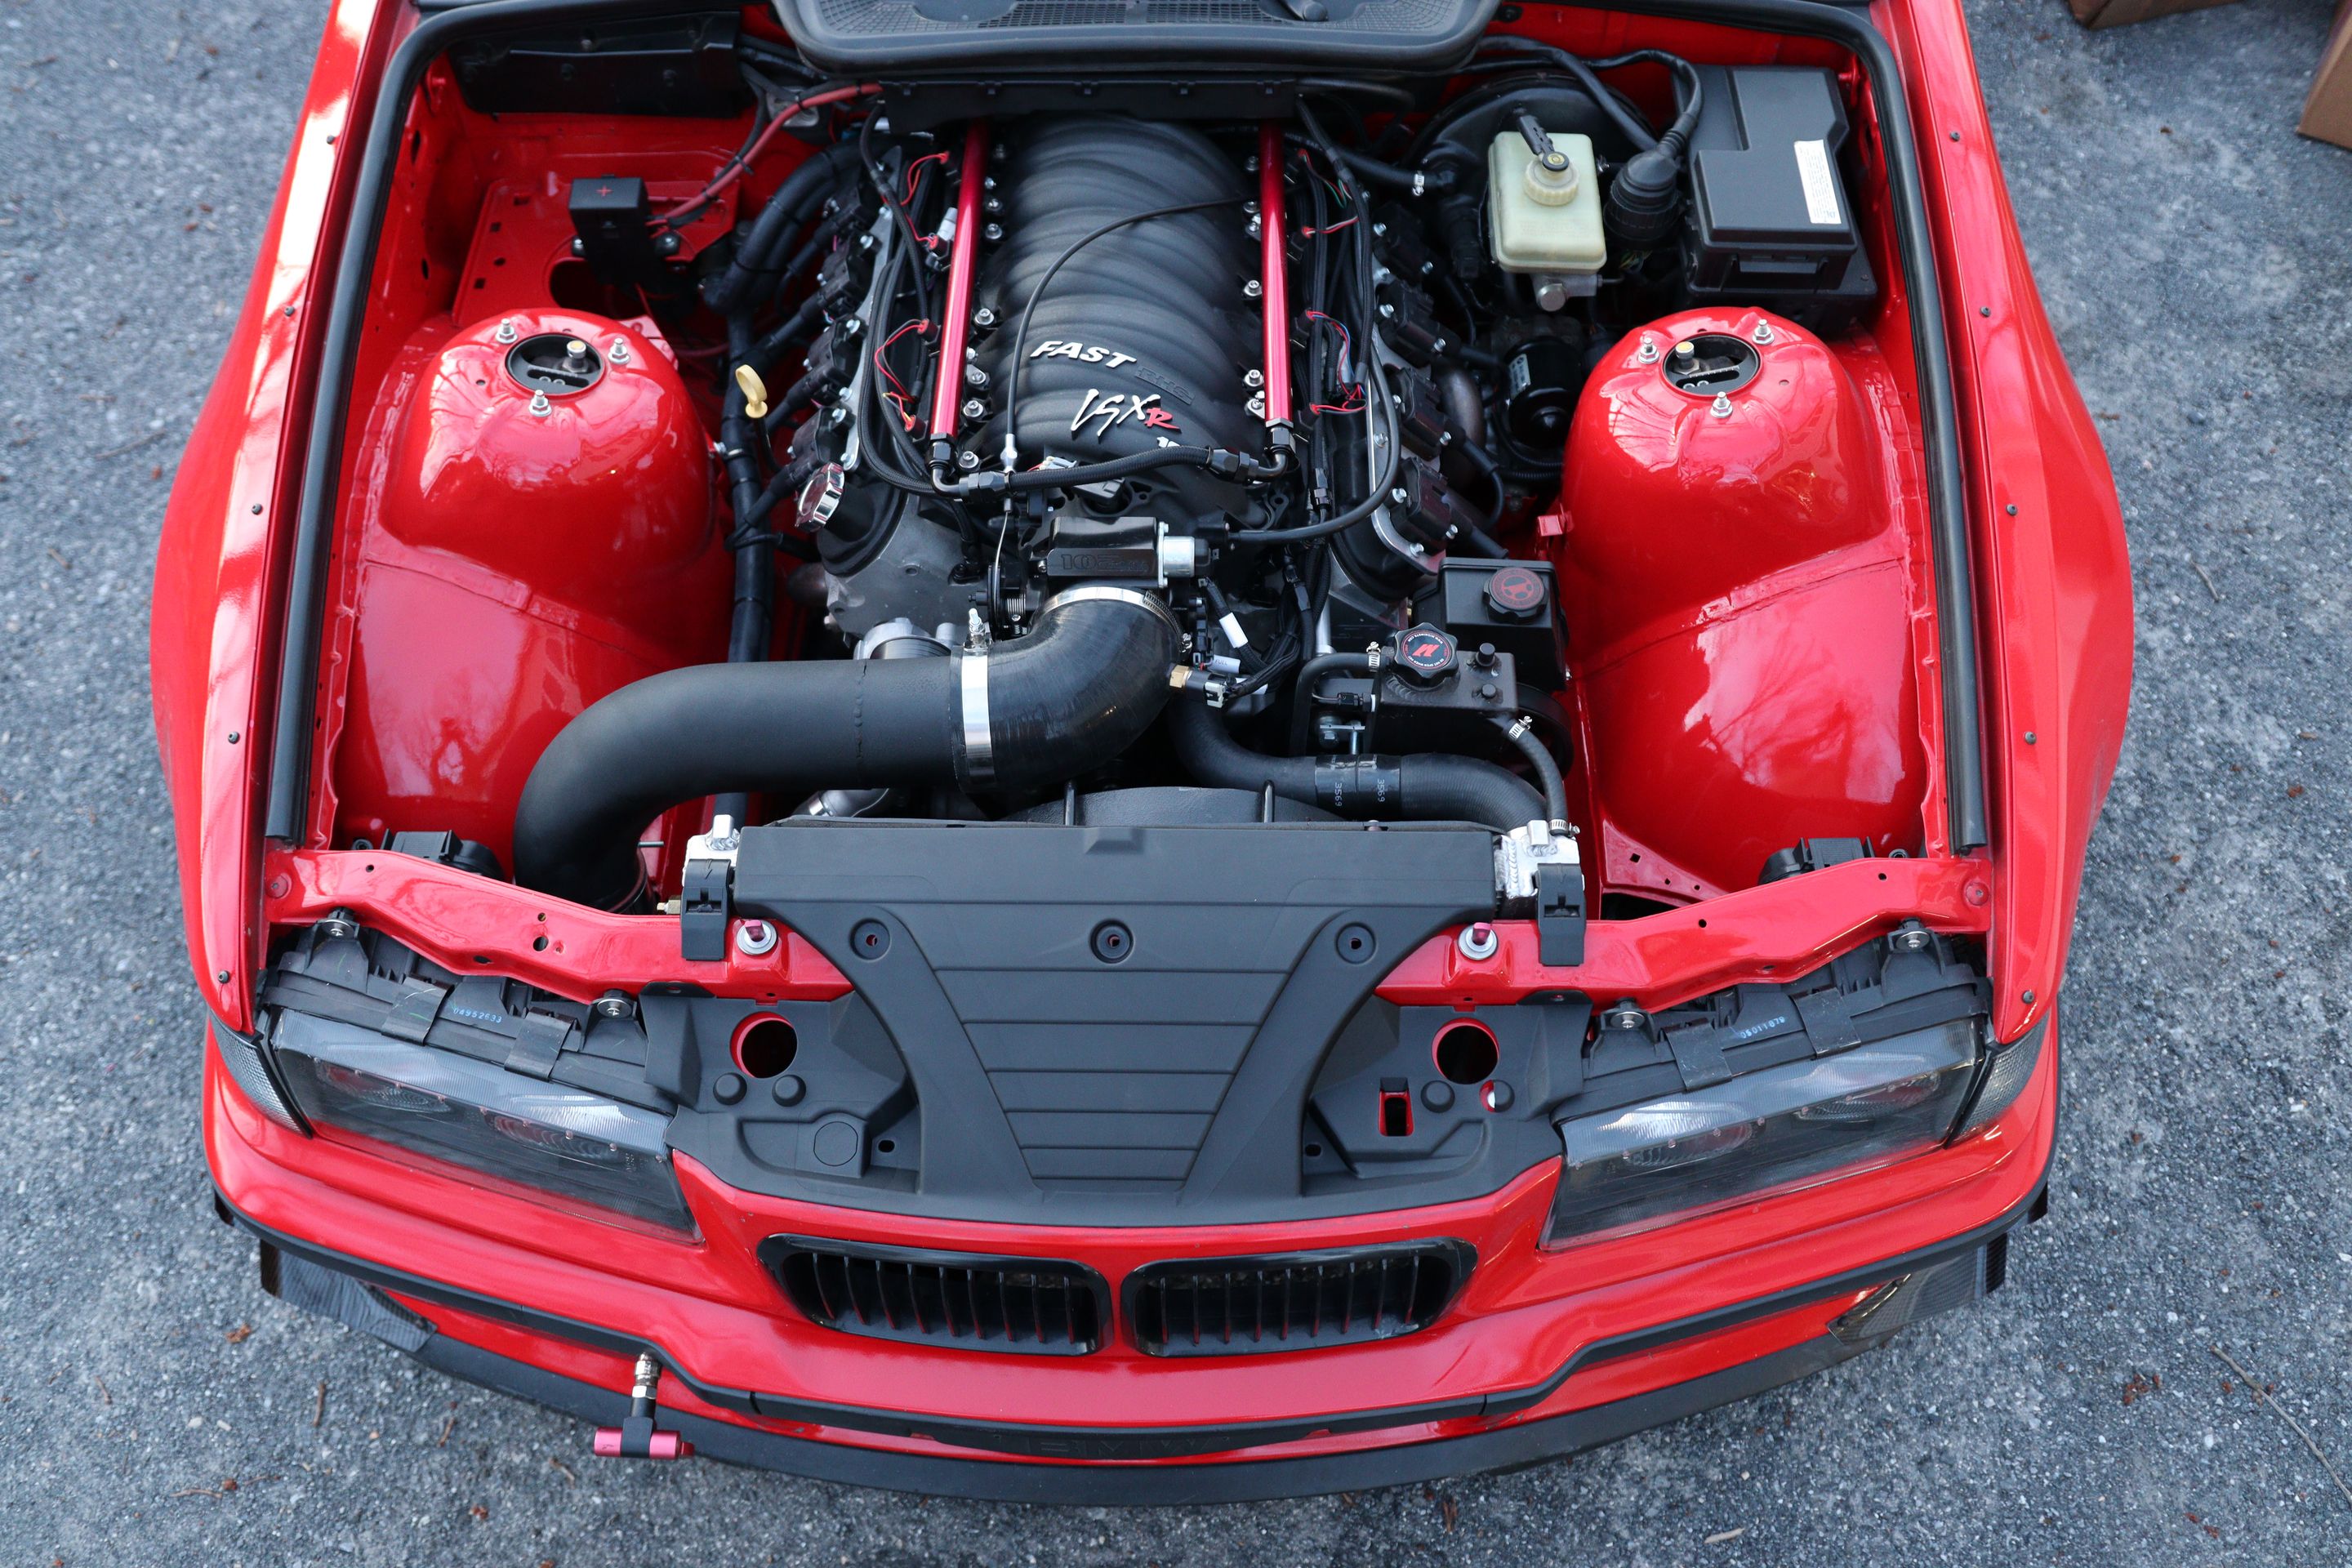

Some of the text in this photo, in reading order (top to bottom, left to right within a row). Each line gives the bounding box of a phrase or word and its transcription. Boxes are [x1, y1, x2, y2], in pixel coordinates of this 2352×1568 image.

[1030, 341, 1138, 368] FAST
[1334, 782, 1343, 807] 3569
[1377, 778, 1386, 802] 3569
